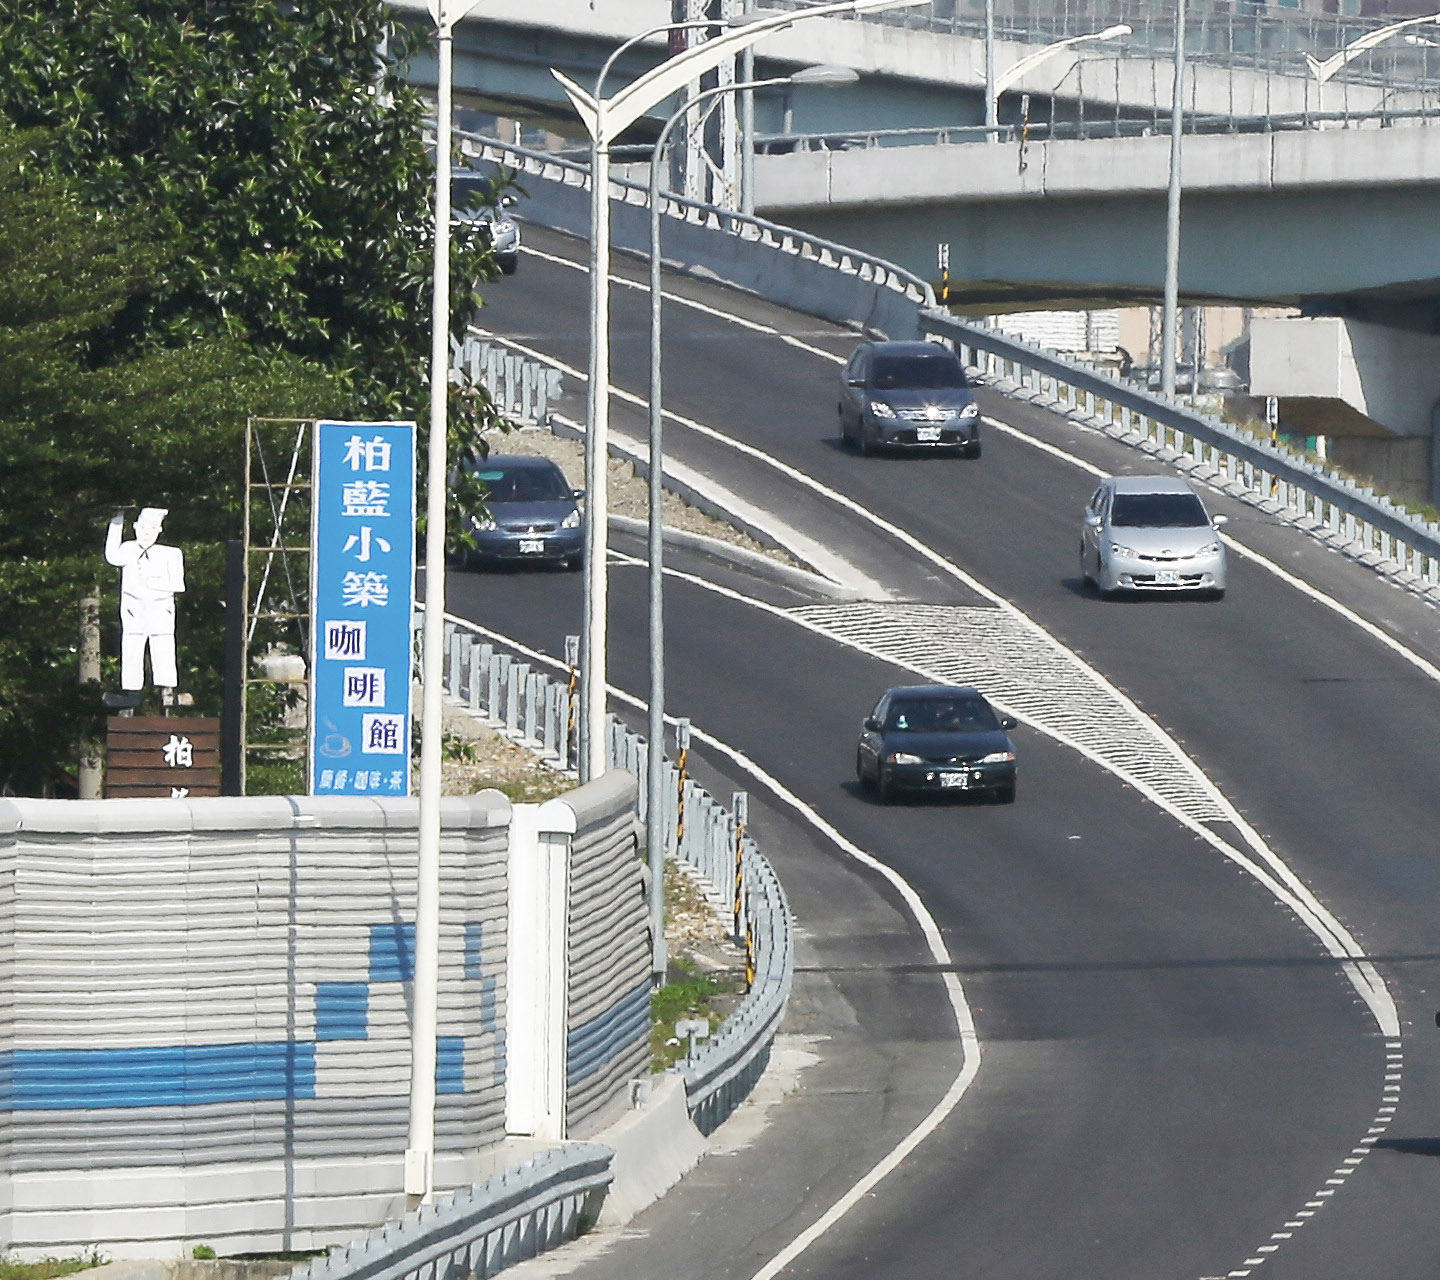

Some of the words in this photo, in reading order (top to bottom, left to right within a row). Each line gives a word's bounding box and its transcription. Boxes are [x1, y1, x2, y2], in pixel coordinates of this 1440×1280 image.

[341, 435, 392, 608] 柏藍小築
[329, 624, 399, 750] 咖啡館
